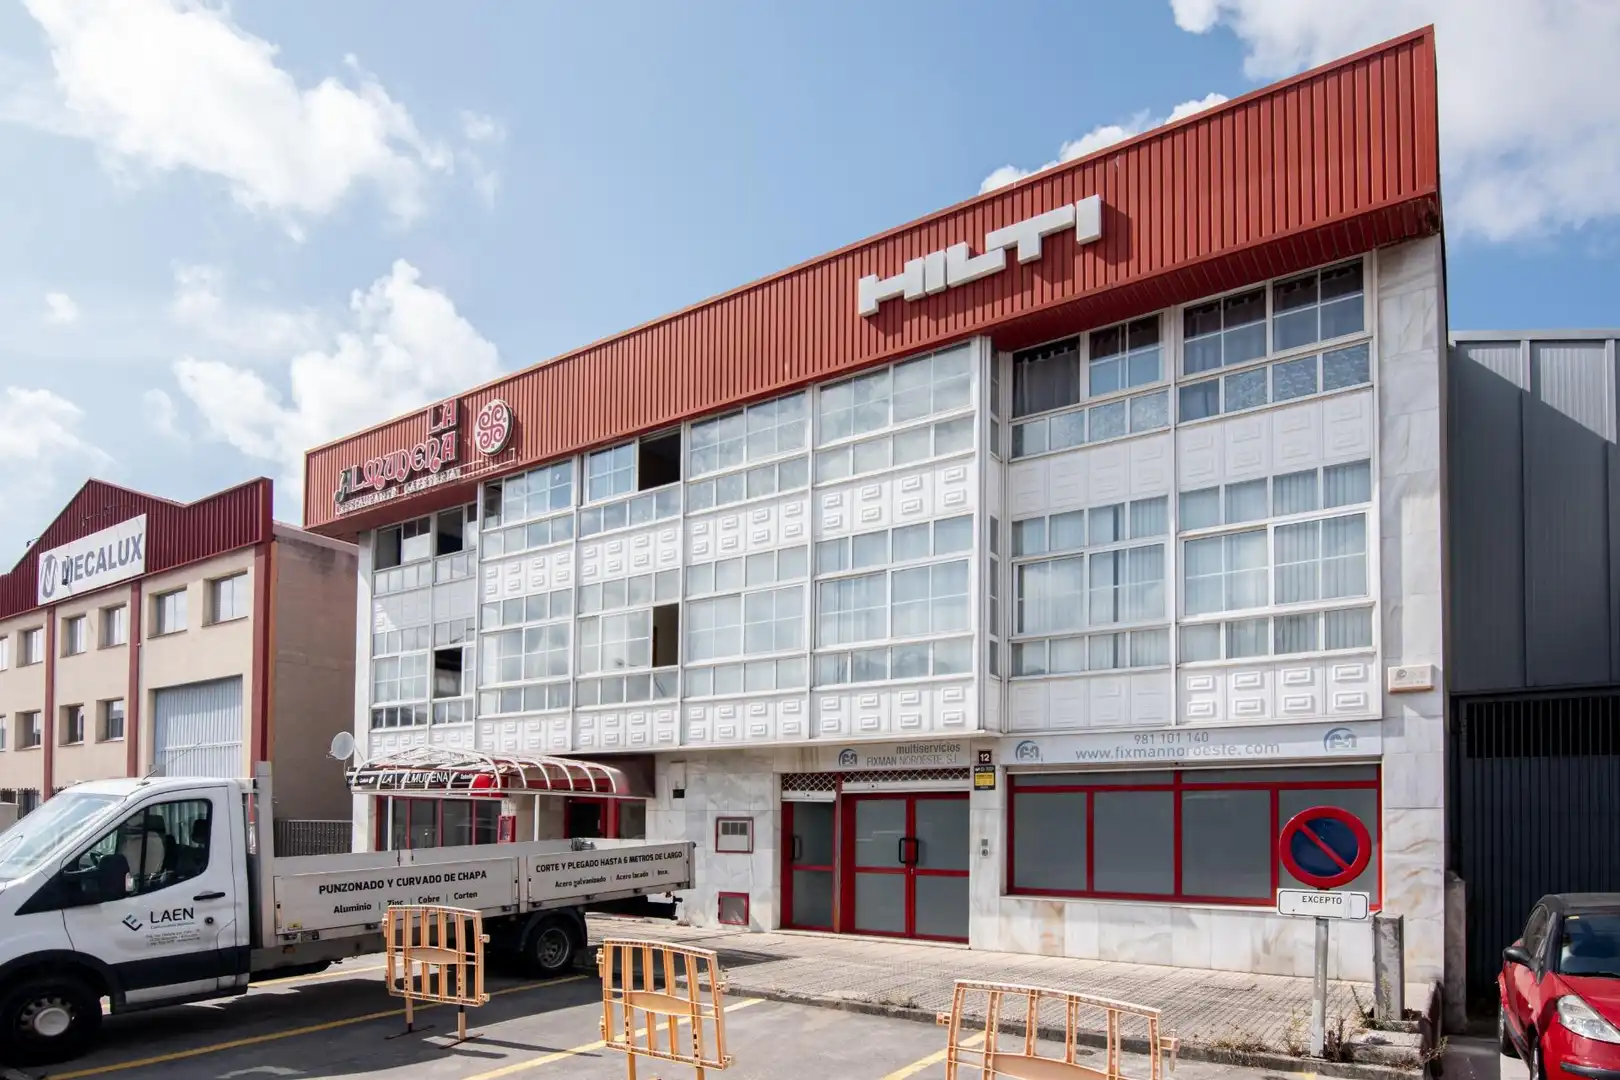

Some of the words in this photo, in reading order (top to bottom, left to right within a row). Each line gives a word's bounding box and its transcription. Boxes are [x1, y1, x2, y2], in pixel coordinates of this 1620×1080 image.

[858, 194, 1101, 317] HILTI
[427, 398, 459, 435] LA
[1134, 734, 1155, 745] 981
[1161, 733, 1180, 744] 101
[1187, 732, 1209, 743] 140
[896, 743, 960, 755] multiservicios
[866, 756, 897, 767] FIXMAN
[899, 754, 942, 766] NOROESTE
[536, 864, 559, 873] CORTE
[561, 862, 566, 870] Y
[567, 859, 599, 870] PLEGADO
[600, 857, 622, 867] HASTA
[629, 854, 653, 863] METROS
[655, 853, 662, 861] DE
[664, 851, 683, 859] LARGO
[319, 880, 384, 894] PUNZONADO
[388, 879, 394, 888] Y
[396, 874, 442, 887] CURVADO
[443, 873, 456, 882] DE
[458, 870, 487, 880] CHAPA
[573, 876, 606, 888] galvanizado
[616, 873, 631, 881] Acero
[632, 871, 649, 879] lacado
[333, 903, 372, 914] Aluminio
[418, 895, 440, 904] Cobre
[454, 891, 478, 900] Corten
[1302, 895, 1343, 905] EXCEPTO
[150, 907, 194, 924] LAEN
